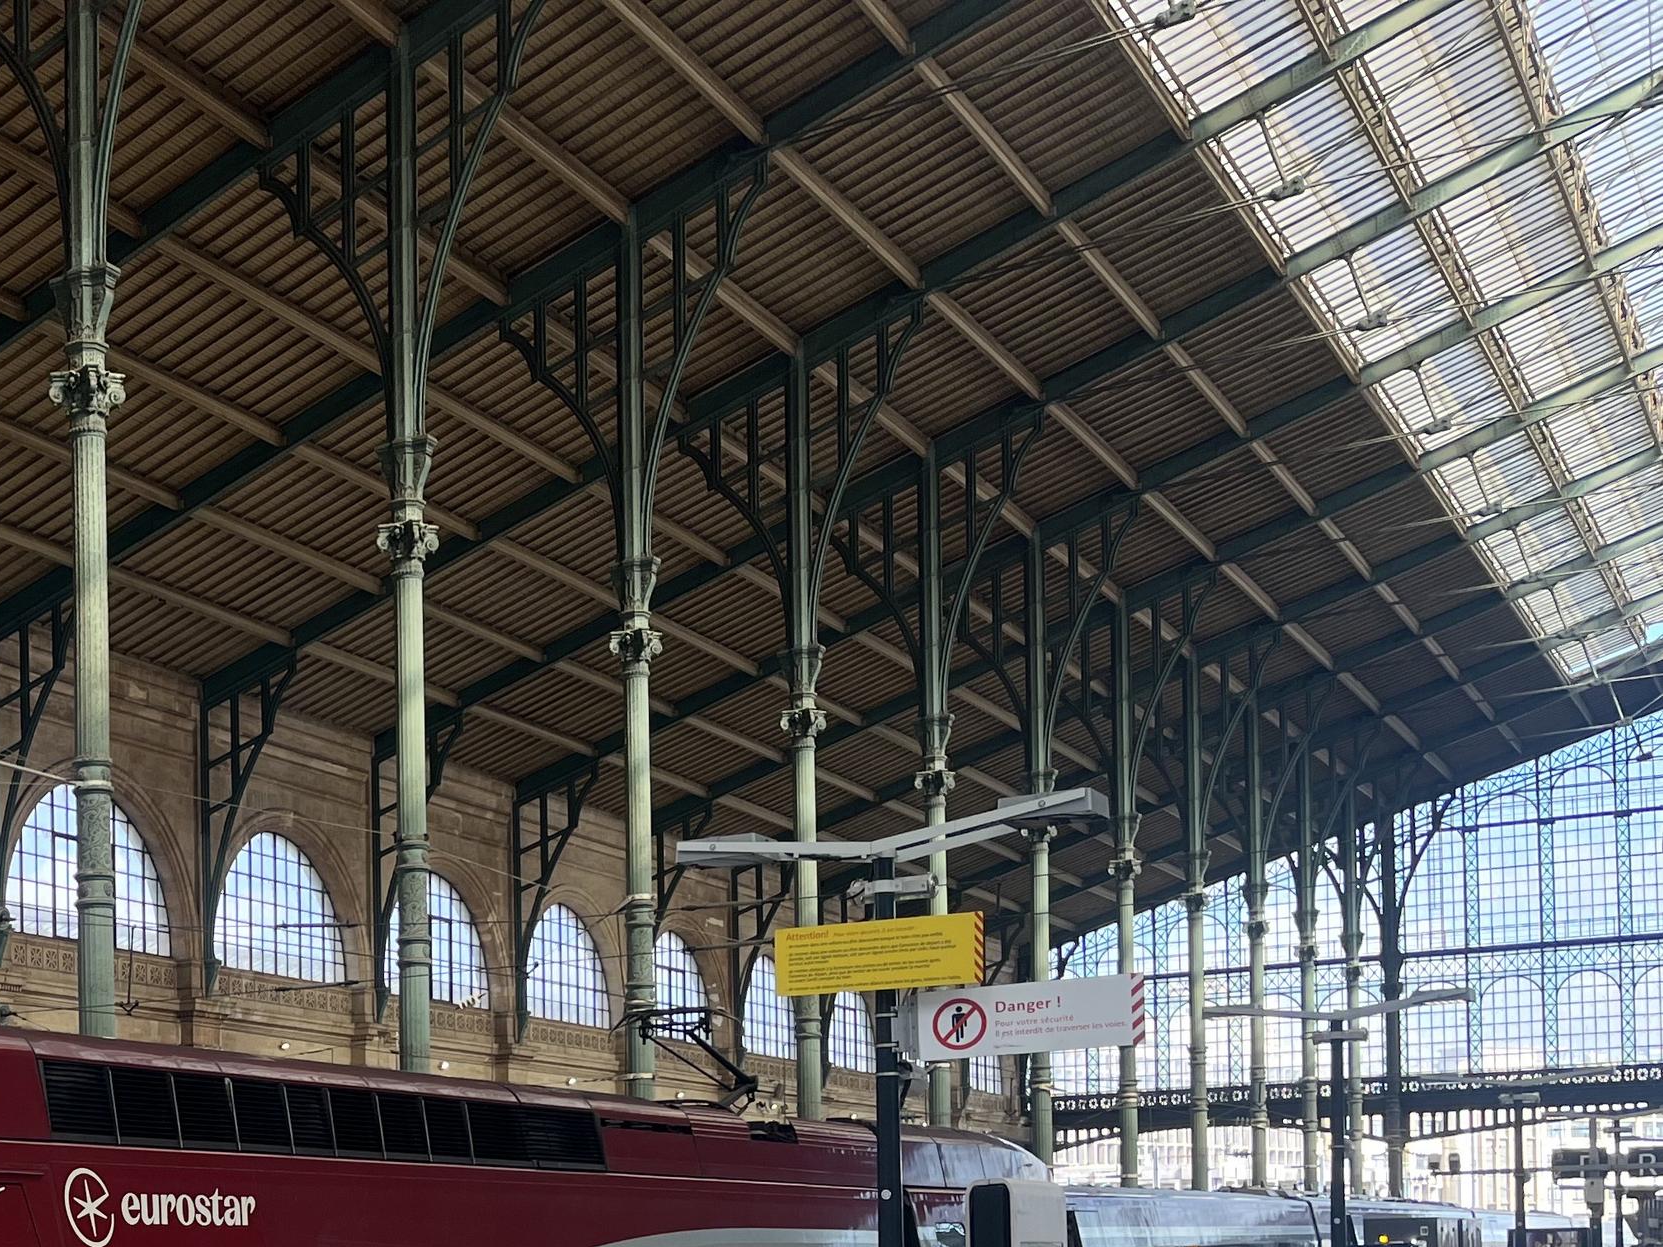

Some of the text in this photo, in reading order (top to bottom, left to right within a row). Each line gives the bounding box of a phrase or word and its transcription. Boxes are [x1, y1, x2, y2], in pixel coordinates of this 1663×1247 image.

[786, 930, 829, 941] Attention!
[995, 999, 1051, 1014] Danger
[1016, 1018, 1038, 1026] votre
[1040, 1014, 1074, 1024] sécurité
[1015, 1027, 1043, 1036] interdit
[1057, 1024, 1090, 1032] traverser
[1092, 1021, 1103, 1029] les
[121, 1188, 256, 1226] eurostar
